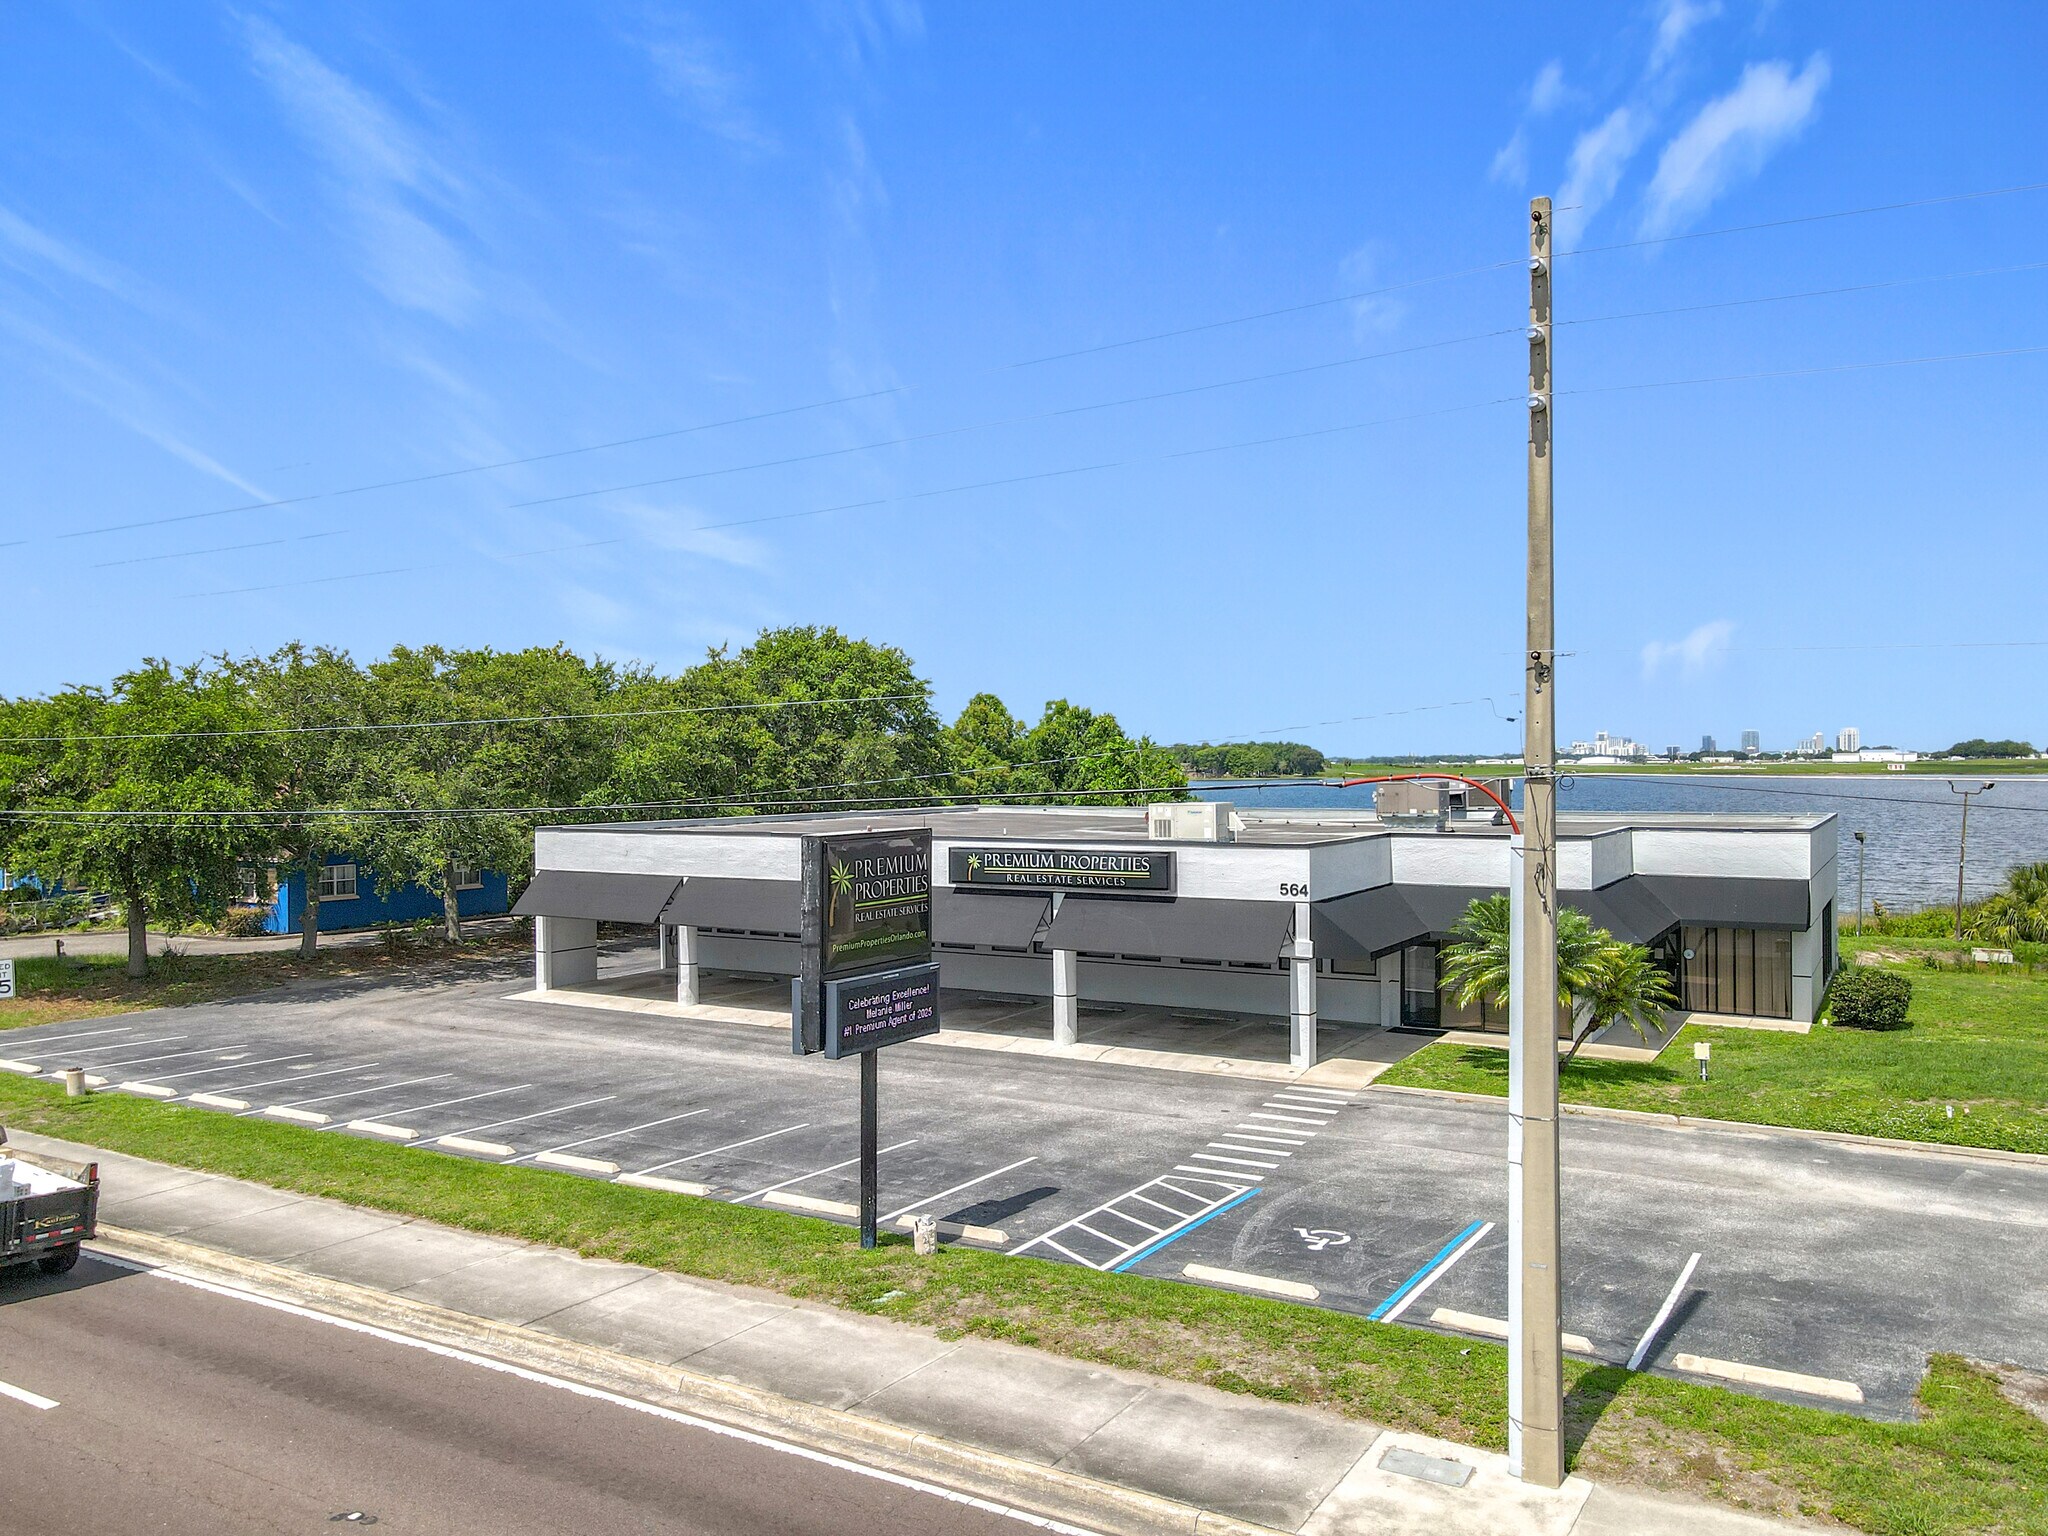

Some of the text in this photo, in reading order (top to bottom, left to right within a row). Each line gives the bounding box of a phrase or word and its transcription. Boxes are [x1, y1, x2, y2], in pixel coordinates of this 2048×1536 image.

[855, 853, 927, 879] PREMIUM
[984, 853, 1150, 871] PREMIUM PROPERTIES
[855, 874, 928, 900] PROPERTIES
[1006, 873, 1126, 886] REAL ESTATE SERVICES
[1280, 883, 1308, 897] 564
[855, 903, 928, 922] REAL ESTATE SERVICES
[832, 930, 927, 953] PremiumPropertiesOrlando.com
[848, 984, 930, 1010] Celebrating Excellence!
[866, 1001, 913, 1019] Melanie Miller
[843, 1025, 852, 1037] #1
[855, 1020, 887, 1035] Premium
[888, 1013, 908, 1028] Agent
[908, 1011, 916, 1021] of
